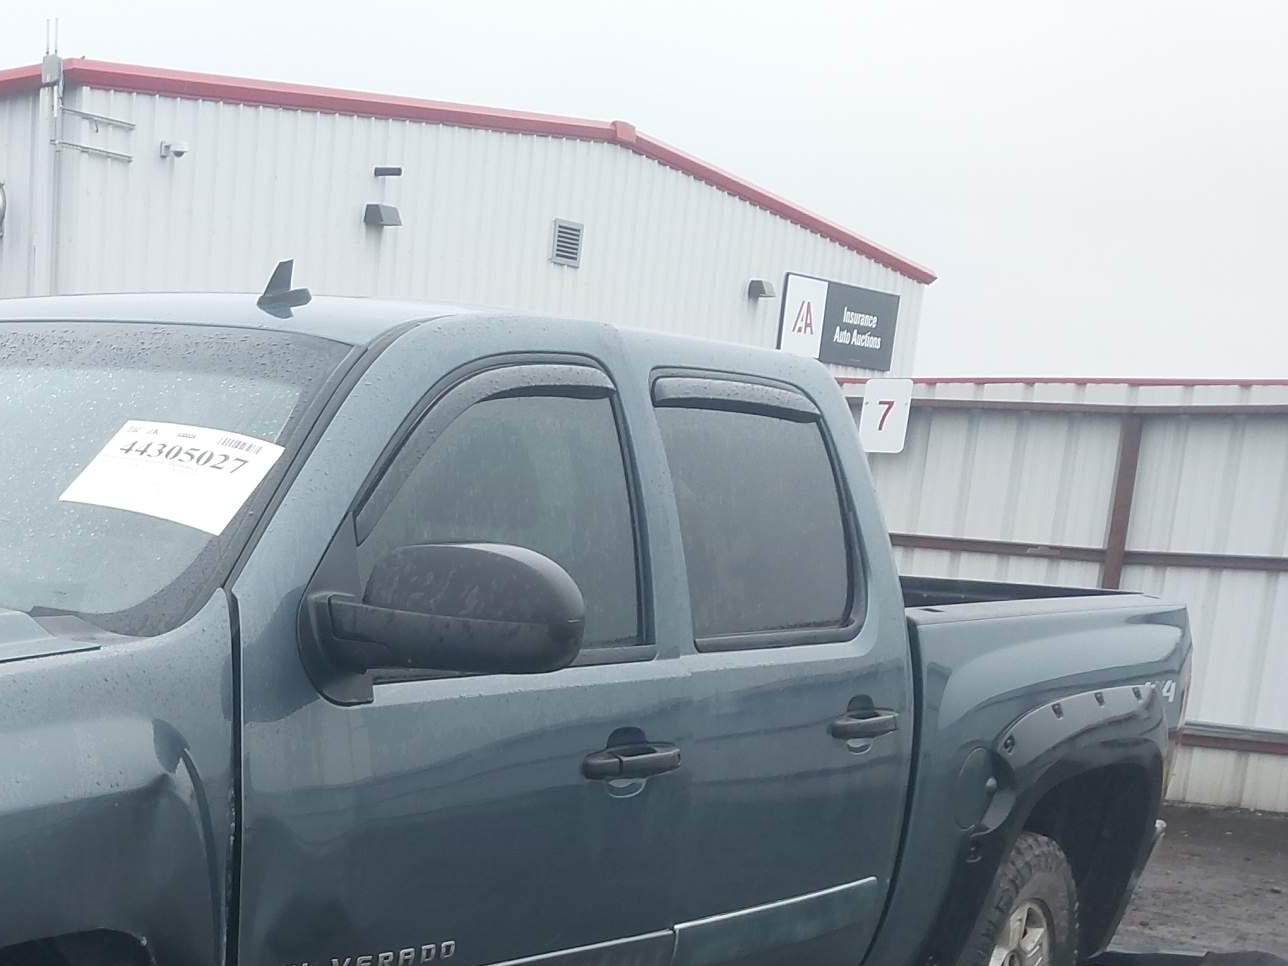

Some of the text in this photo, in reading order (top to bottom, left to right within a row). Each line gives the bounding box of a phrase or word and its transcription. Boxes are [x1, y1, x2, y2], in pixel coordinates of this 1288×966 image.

[843, 306, 878, 328] Insurance
[833, 326, 882, 349] Auto Auctions
[878, 400, 895, 431] 7
[119, 440, 249, 474] 44305027
